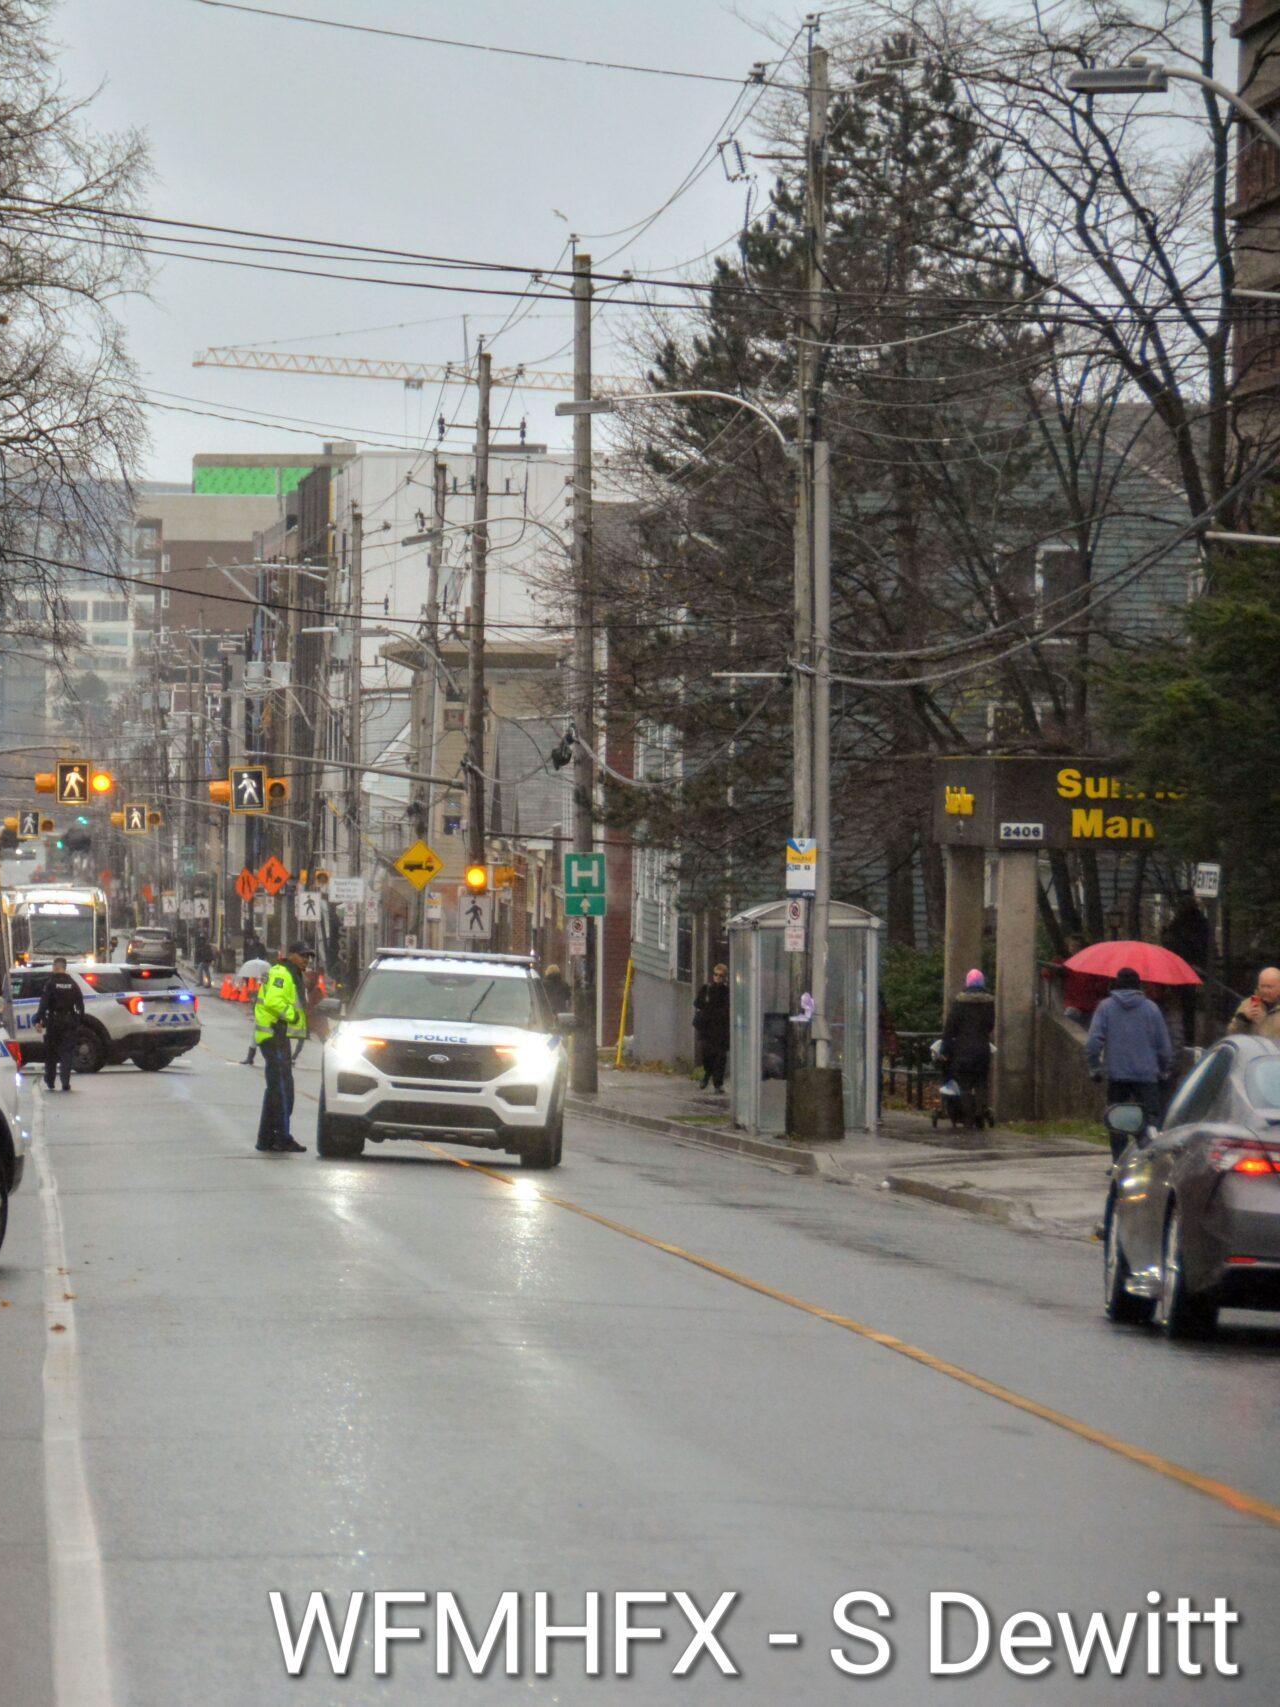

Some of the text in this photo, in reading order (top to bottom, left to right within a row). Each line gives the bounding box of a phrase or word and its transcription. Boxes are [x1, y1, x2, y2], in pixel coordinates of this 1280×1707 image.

[1003, 826, 1041, 837] 2406
[1071, 808, 1155, 838] Man
[571, 861, 599, 887] H
[1196, 870, 1218, 890] ENTER
[413, 1033, 468, 1044] POLICE
